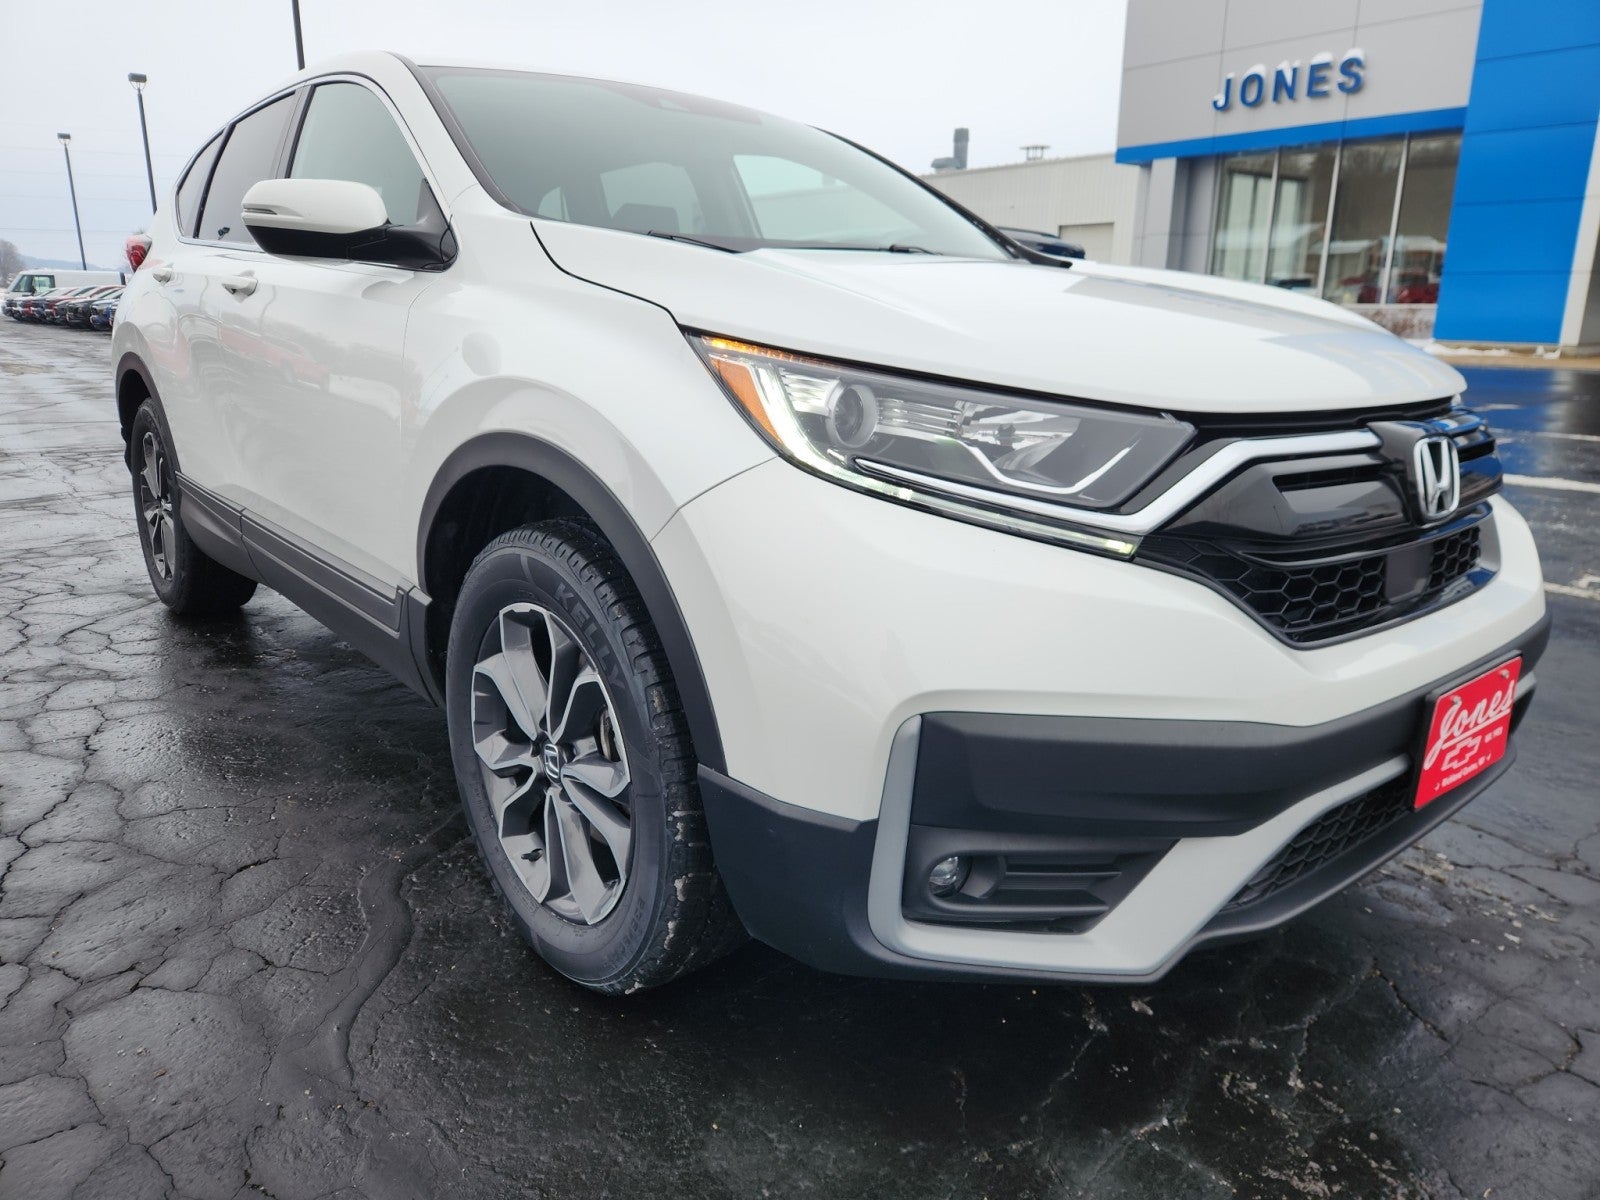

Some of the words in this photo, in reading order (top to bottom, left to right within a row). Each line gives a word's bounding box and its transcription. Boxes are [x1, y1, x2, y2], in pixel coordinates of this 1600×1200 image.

[1212, 56, 1366, 112] JONES
[554, 582, 626, 690] KELLY
[1423, 680, 1516, 771] Jones
